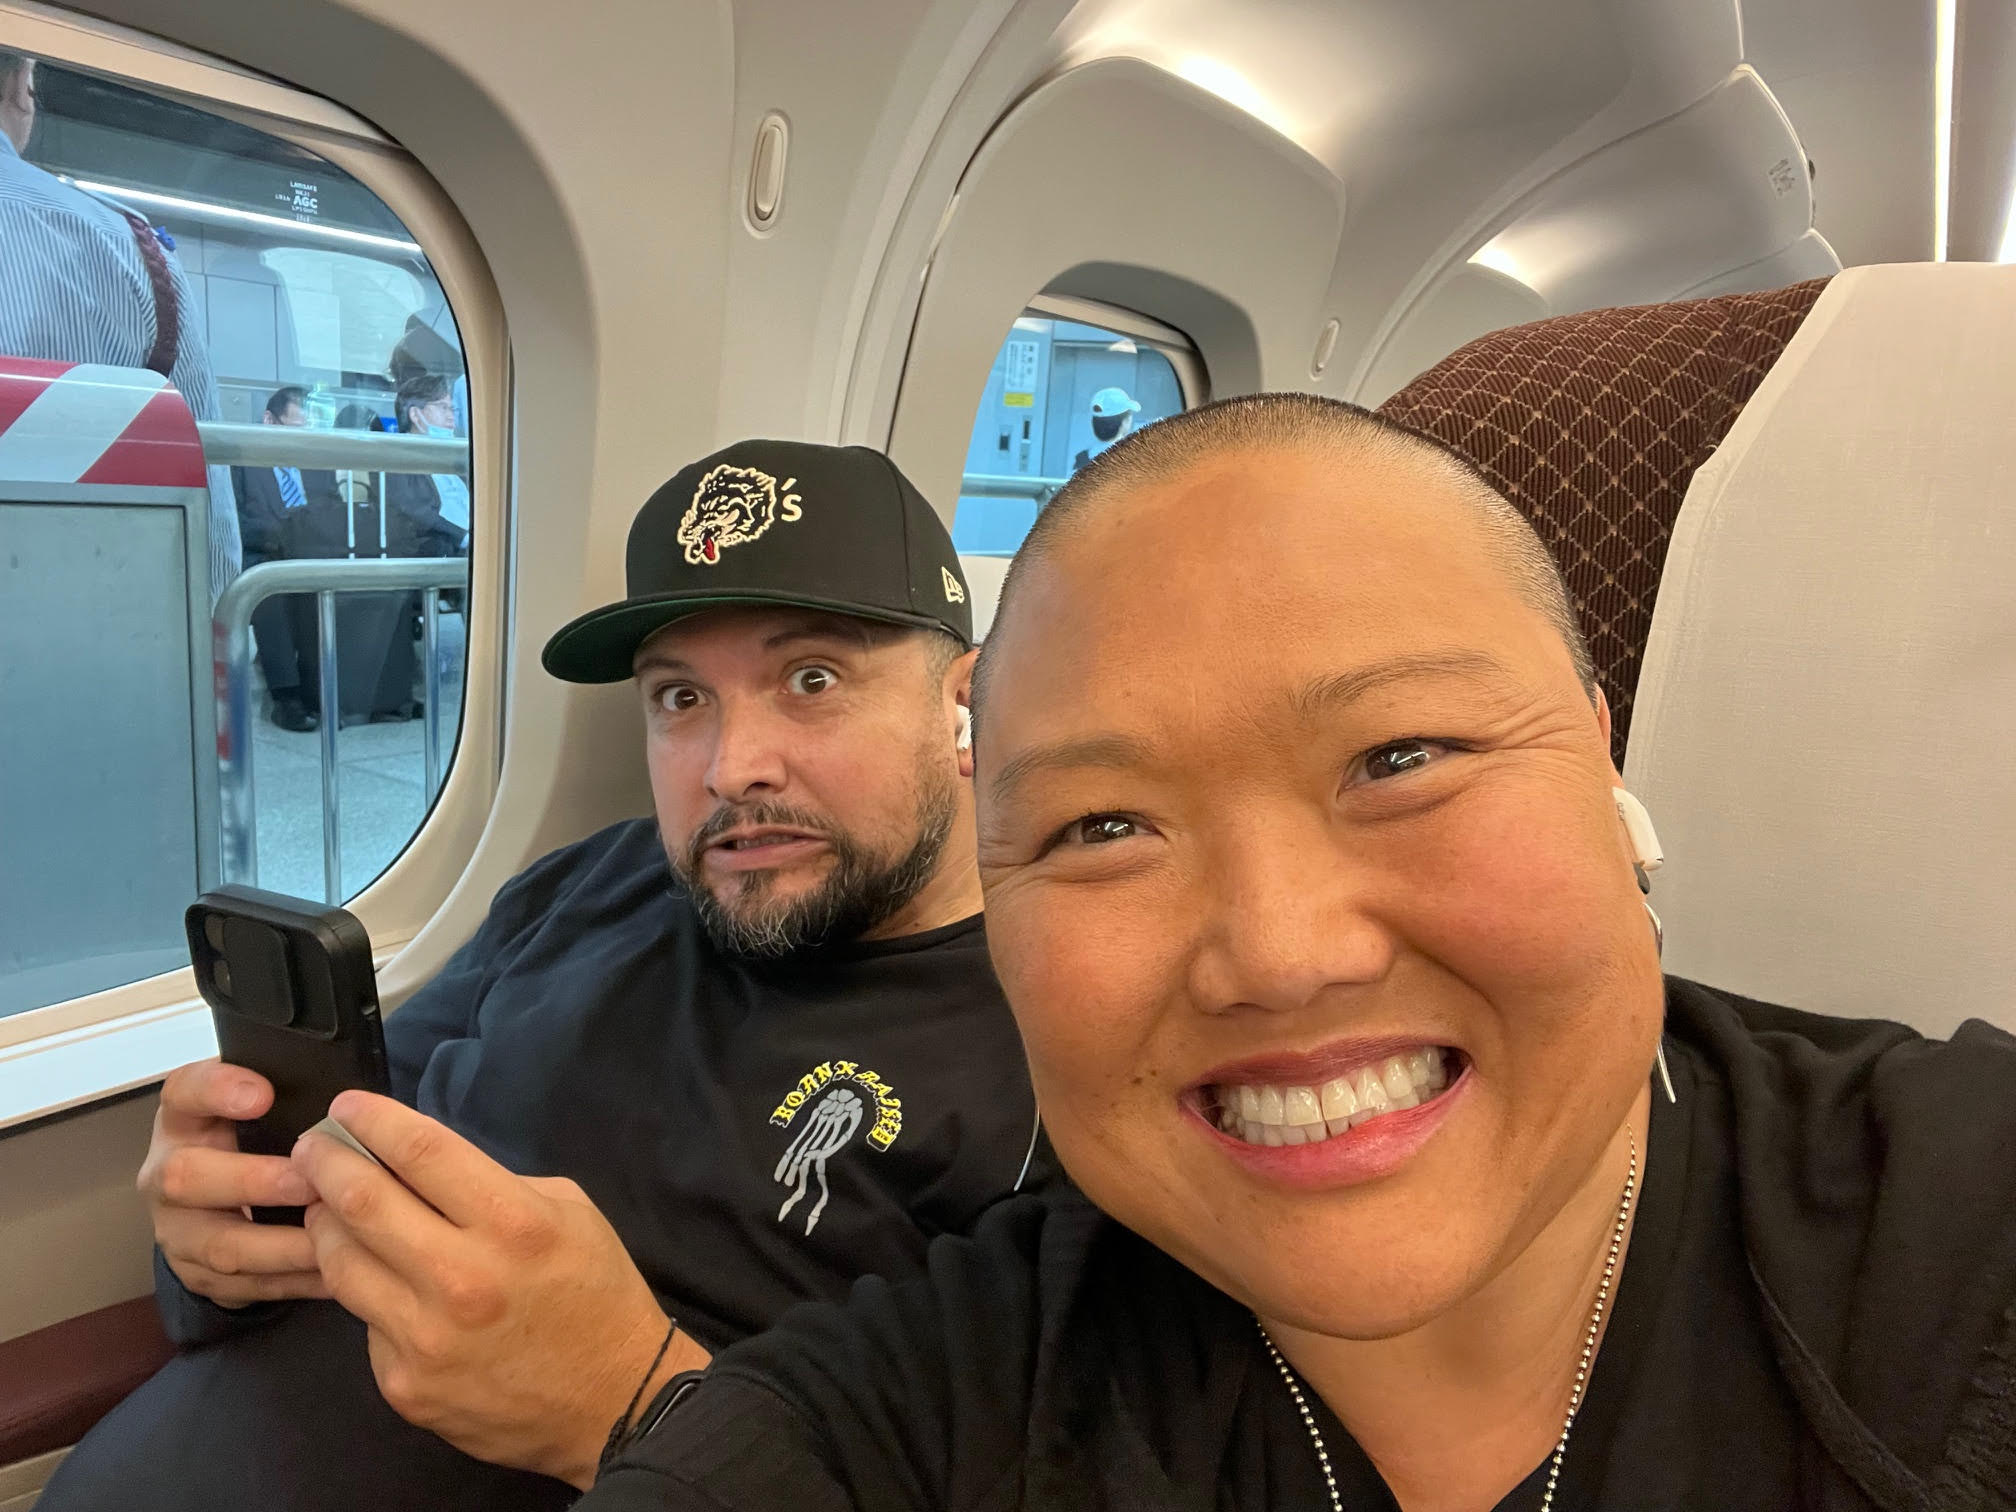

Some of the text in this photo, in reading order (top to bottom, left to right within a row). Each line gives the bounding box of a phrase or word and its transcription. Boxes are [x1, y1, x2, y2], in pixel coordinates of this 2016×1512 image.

[293, 195, 318, 209] AGC
[769, 1061, 833, 1128] BORN
[832, 1060, 859, 1081] X
